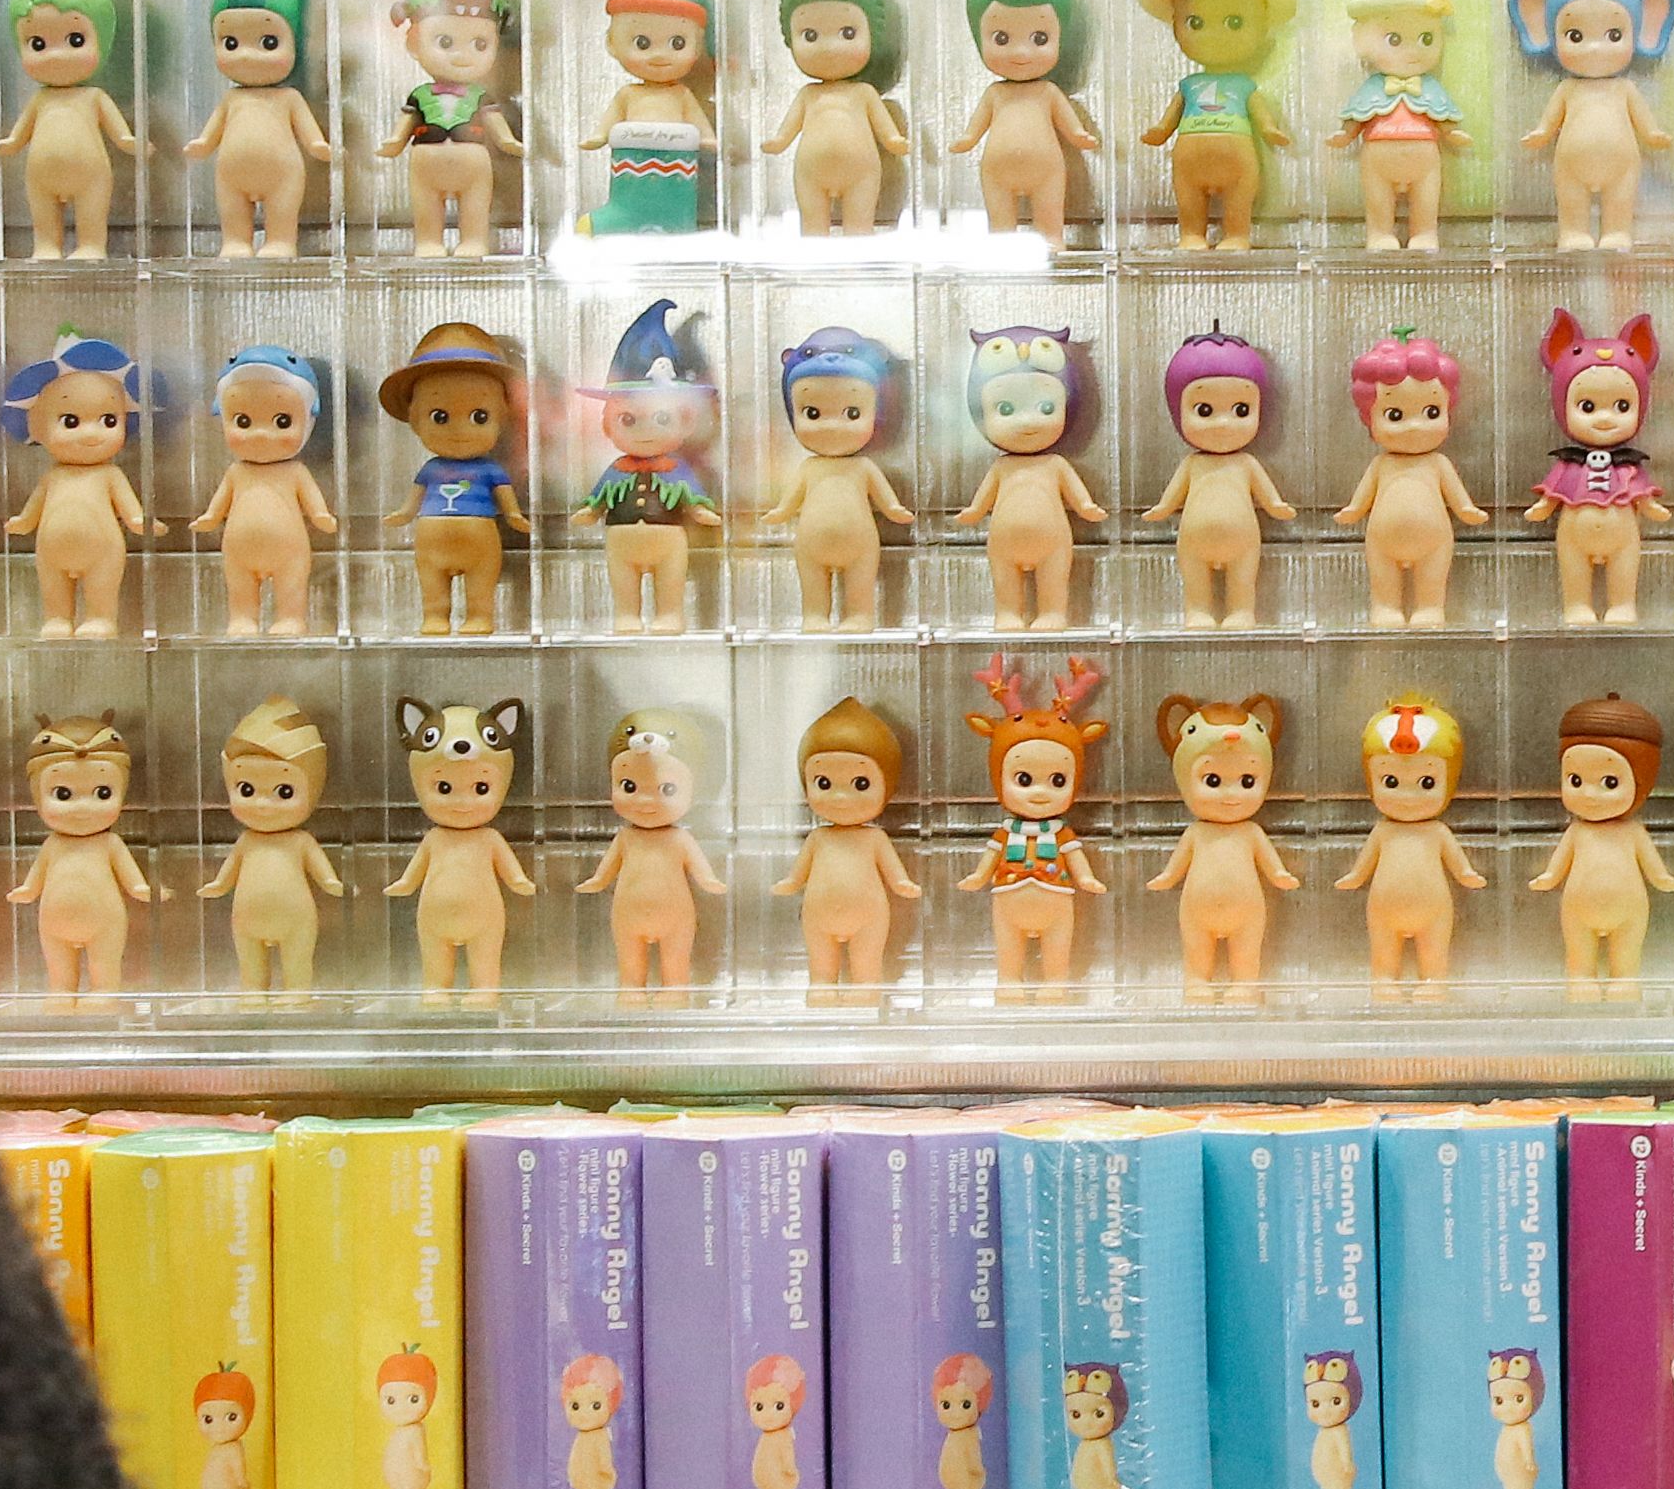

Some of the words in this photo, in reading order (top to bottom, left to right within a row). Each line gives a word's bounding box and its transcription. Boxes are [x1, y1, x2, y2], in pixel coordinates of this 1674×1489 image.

[43, 1158, 71, 1251] Sonny
[413, 1144, 442, 1238] Sonny
[521, 1172, 533, 1211] Kinds
[600, 1148, 629, 1240] Sonny
[782, 1147, 809, 1241] Sonny
[891, 1172, 904, 1211] Kinds
[969, 1147, 997, 1239] Sonny
[1099, 1154, 1129, 1248] Sonny
[1335, 1142, 1362, 1236] Sonny
[1519, 1140, 1546, 1233] Sonny
[1634, 1159, 1646, 1197] Kinds
[521, 1223, 533, 1266] Secret
[891, 1223, 904, 1266] Secret
[1634, 1209, 1647, 1252] Secret
[413, 1245, 443, 1329] Angel
[601, 1247, 629, 1331] Angel
[782, 1248, 810, 1330] Angel
[970, 1247, 997, 1330] Angel
[1102, 1256, 1134, 1339] Angel
[1337, 1243, 1365, 1326] Angel
[1520, 1241, 1549, 1324] Angel
